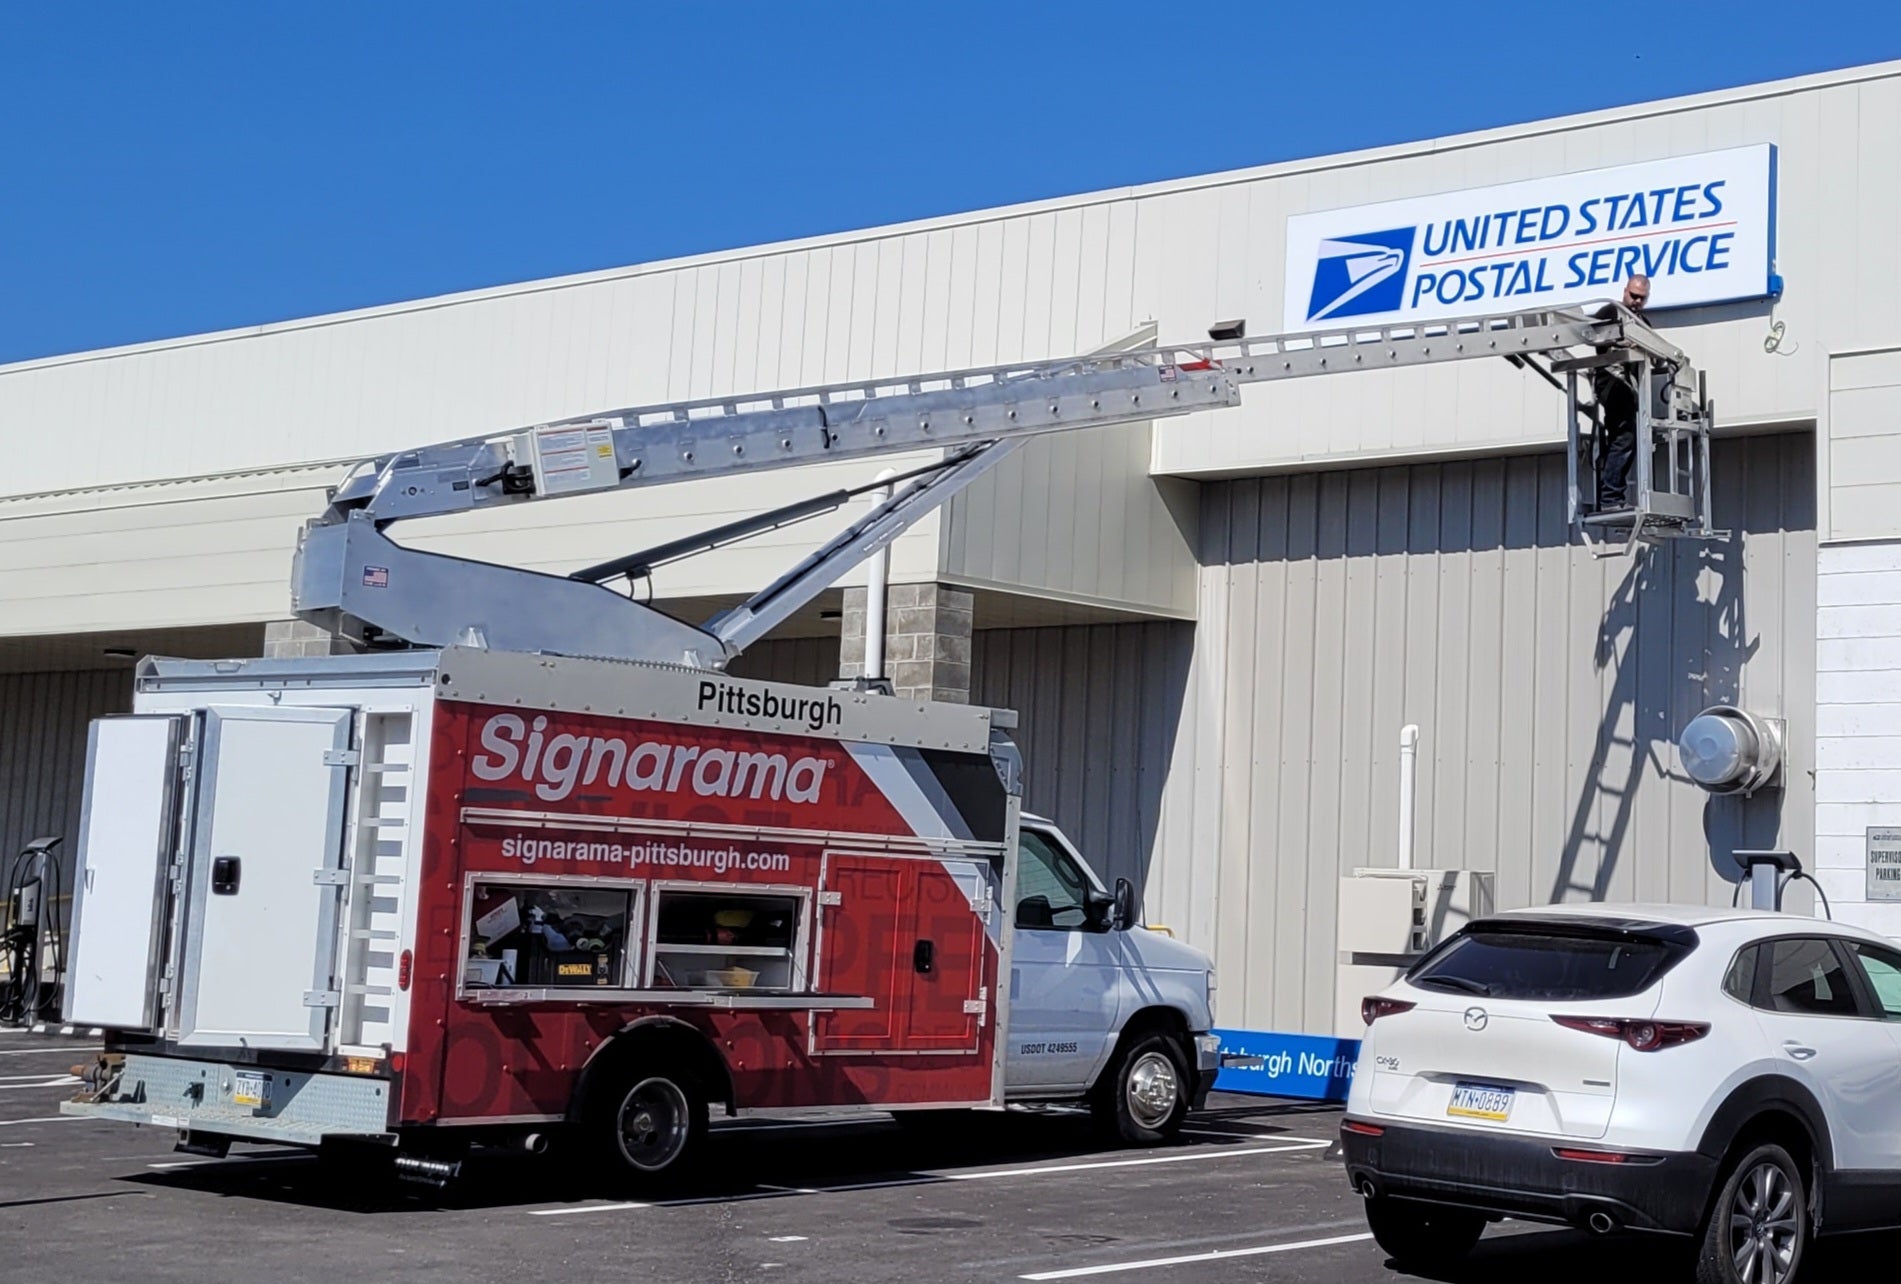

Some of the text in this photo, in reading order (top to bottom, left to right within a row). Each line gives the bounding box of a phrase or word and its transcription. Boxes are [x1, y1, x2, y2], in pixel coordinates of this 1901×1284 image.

[1423, 180, 1726, 257] UNITED STATES
[1411, 232, 1735, 309] POSTAL SERVICE
[697, 680, 842, 731] Pittsburgh
[501, 834, 790, 873] signarama-pittsburgh.com
[1021, 1043, 1046, 1054] USDOT
